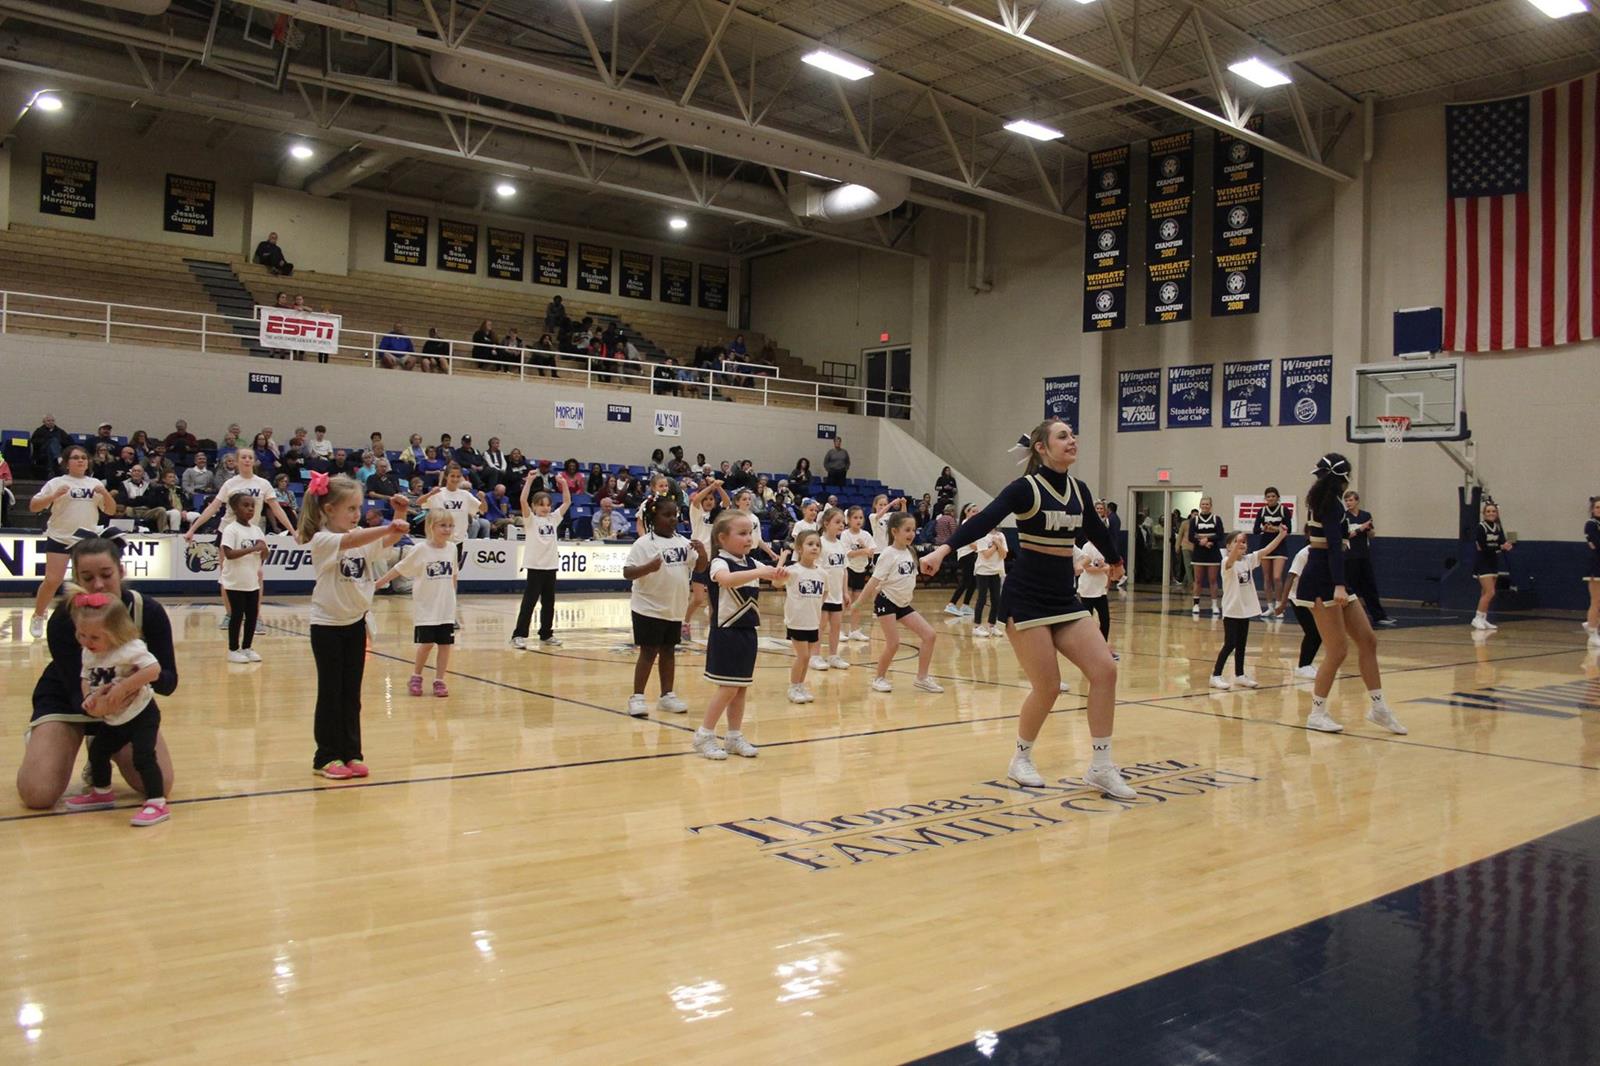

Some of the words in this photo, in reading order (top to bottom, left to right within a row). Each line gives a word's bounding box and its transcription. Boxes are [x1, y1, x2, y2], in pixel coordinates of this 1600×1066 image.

[1156, 176, 1184, 187] CHAMPION
[63, 186, 75, 194] 20
[1216, 182, 1262, 196] WINGATE
[42, 194, 94, 209] Harrington
[1149, 195, 1191, 209] WINGATE
[173, 210, 206, 220] Jessica
[1088, 208, 1128, 221] WINGATE
[1223, 227, 1254, 239] CHAMPION
[1154, 239, 1183, 250] CHAMPION
[1093, 249, 1120, 260] CHAMPION
[1160, 248, 1178, 258] 2007
[1216, 251, 1258, 263] WINGATE
[1149, 260, 1190, 272] WINGATE
[1087, 270, 1125, 281] WINGATE
[1221, 292, 1250, 303] CHAMPION
[1154, 303, 1184, 313] CHAMPION
[1091, 311, 1118, 321] CHAMPION
[1160, 311, 1178, 321] 2007
[266, 315, 334, 339] ESPN
[1225, 363, 1270, 375] Wingate
[1282, 358, 1331, 371] Wingate
[251, 374, 280, 384] SECTION
[1120, 371, 1160, 383] Wingate
[1169, 368, 1212, 379] Wingate
[1046, 381, 1078, 391] Wingate
[1228, 377, 1267, 391] BULLDOGS
[1286, 373, 1328, 388] BULLDOGS
[262, 384, 268, 392] C
[1122, 385, 1157, 398] BULLDOGS
[1172, 381, 1208, 394] BULLDOGS
[1047, 394, 1078, 406] BULLDOGS
[555, 406, 584, 420] MORGAN
[1170, 406, 1210, 416] Stonebridge
[1298, 407, 1315, 416] KING
[655, 413, 680, 428] ALYSIA
[477, 550, 506, 564] SAC
[687, 793, 1004, 844] Thomas
[973, 759, 1201, 798] Kontz
[767, 807, 1063, 872] FAMILY
[1060, 770, 1262, 814] COURT
